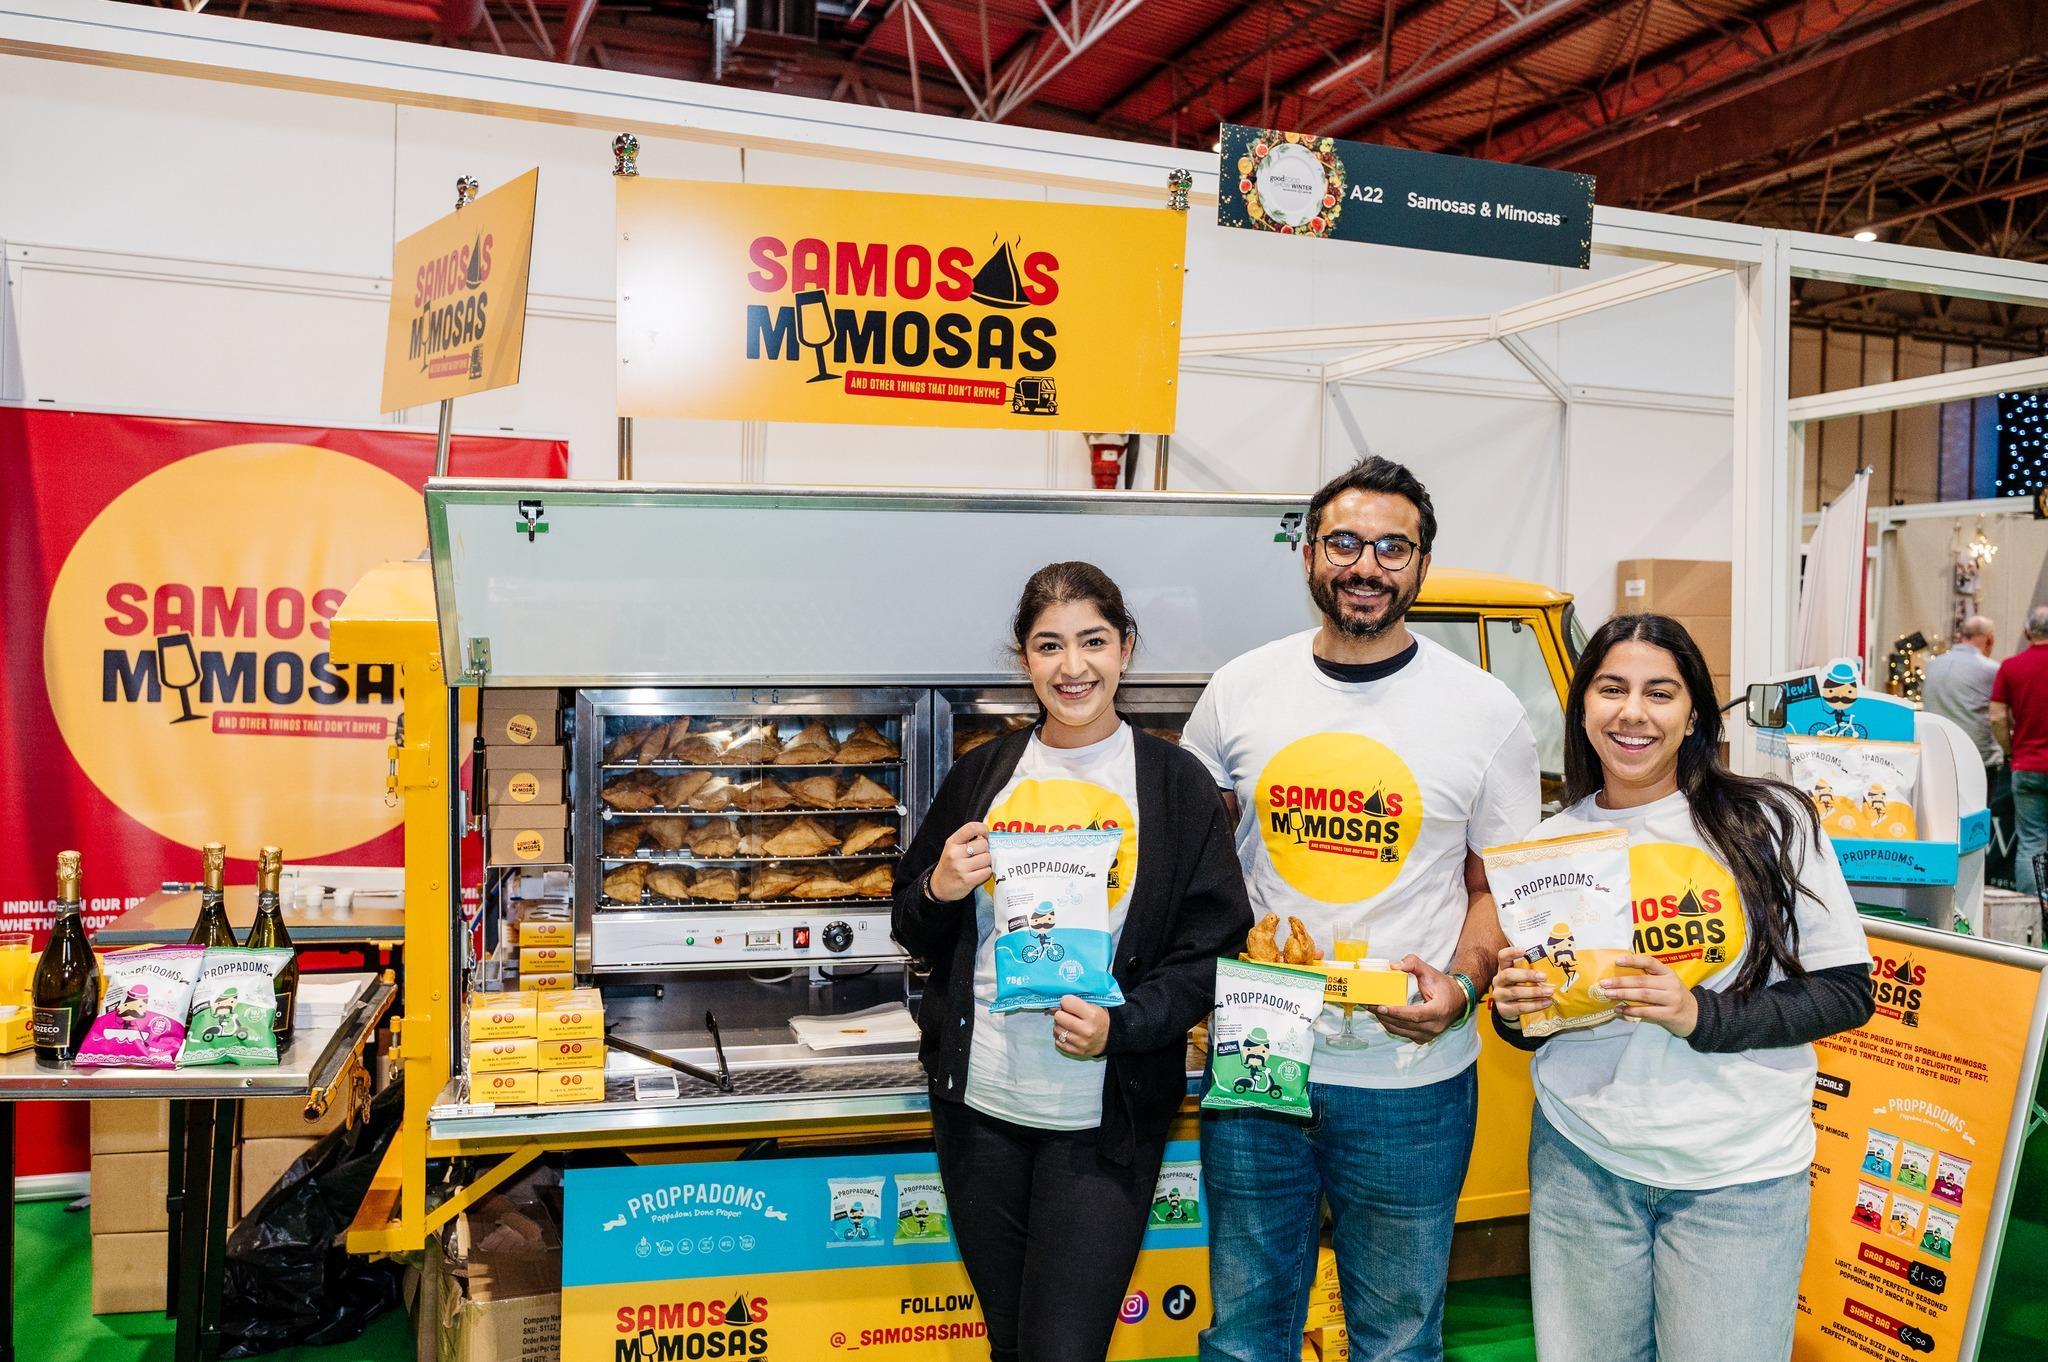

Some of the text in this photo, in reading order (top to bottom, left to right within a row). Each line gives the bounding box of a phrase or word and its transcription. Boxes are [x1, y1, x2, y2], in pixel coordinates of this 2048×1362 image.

[1350, 184, 1561, 226] A22 Samosas & Mimosas
[747, 236, 1059, 308] SAMOSAS
[851, 377, 1000, 399] AND OTHER THINGS THAT DON'T RHYME
[104, 582, 346, 640] SAMOS
[102, 649, 405, 706] MIMOSA
[218, 716, 381, 735] AND OTHER THINGS THAT DON'T RHYME
[1269, 784, 1403, 817] SAMOSAS
[1007, 861, 1086, 878] PROPPADOMS
[1842, 849, 1914, 866] PROPPADOMS
[1514, 873, 1594, 900] PROPPADOMS
[3, 900, 57, 914] INDULG
[91, 898, 121, 911] OUR
[1632, 889, 1722, 924] OSAS
[0, 916, 54, 931] WHETH
[203, 961, 269, 980] PROPPADOMS
[1225, 992, 1300, 1015] PROPPADOMS
[1839, 1035, 1852, 1045] FOR
[1860, 1041, 1878, 1052] QUICK
[1880, 1046, 1902, 1058] SNACK
[1904, 1053, 1913, 1062] OR
[1922, 1057, 1962, 1076] DELIGHTFUL
[1870, 1033, 1893, 1045] PAIRED
[1896, 1040, 1912, 1050] WITH
[1914, 1045, 1952, 1062] SPARKLING
[1813, 1040, 1961, 1085] OMETHING TO TANTALIZE YOUR TASTE BUDS!
[1816, 1077, 1844, 1092] PECIALS
[1889, 1097, 1965, 1133] PROPPADOMS
[627, 1183, 766, 1219] PROPPADOMS
[838, 1187, 875, 1198] PROPPADOMS
[903, 1184, 941, 1194] PROPPADOMS
[651, 1210, 693, 1223] Poppadoms
[694, 1208, 714, 1217] Done
[1864, 1249, 1900, 1271] GRAB BAG
[900, 1294, 974, 1315] FOLLOW
[1839, 1269, 1874, 1290] POPPADOMS
[1875, 1285, 1883, 1294] TO
[1885, 1290, 1904, 1304] SNACK
[1905, 1300, 1914, 1308] ON
[1915, 1304, 1927, 1313] THE
[1869, 1272, 1881, 1283] AND
[1882, 1278, 1915, 1298] PERFECTLY
[1915, 1293, 1948, 1312] SEASONED
[523, 1316, 550, 1325] Company
[616, 1297, 768, 1333] SAMOSAS
[1849, 1305, 1891, 1330] SHARE BAG
[522, 1336, 539, 1345] Order
[830, 1321, 986, 1351] @_SAMOSASAND
[1821, 1326, 1883, 1361] PERFECT FOR SHARING
[1832, 1321, 1869, 1342] GENEROUSLY
[1870, 1339, 1887, 1352] SIZED
[1887, 1347, 1900, 1358] AND
